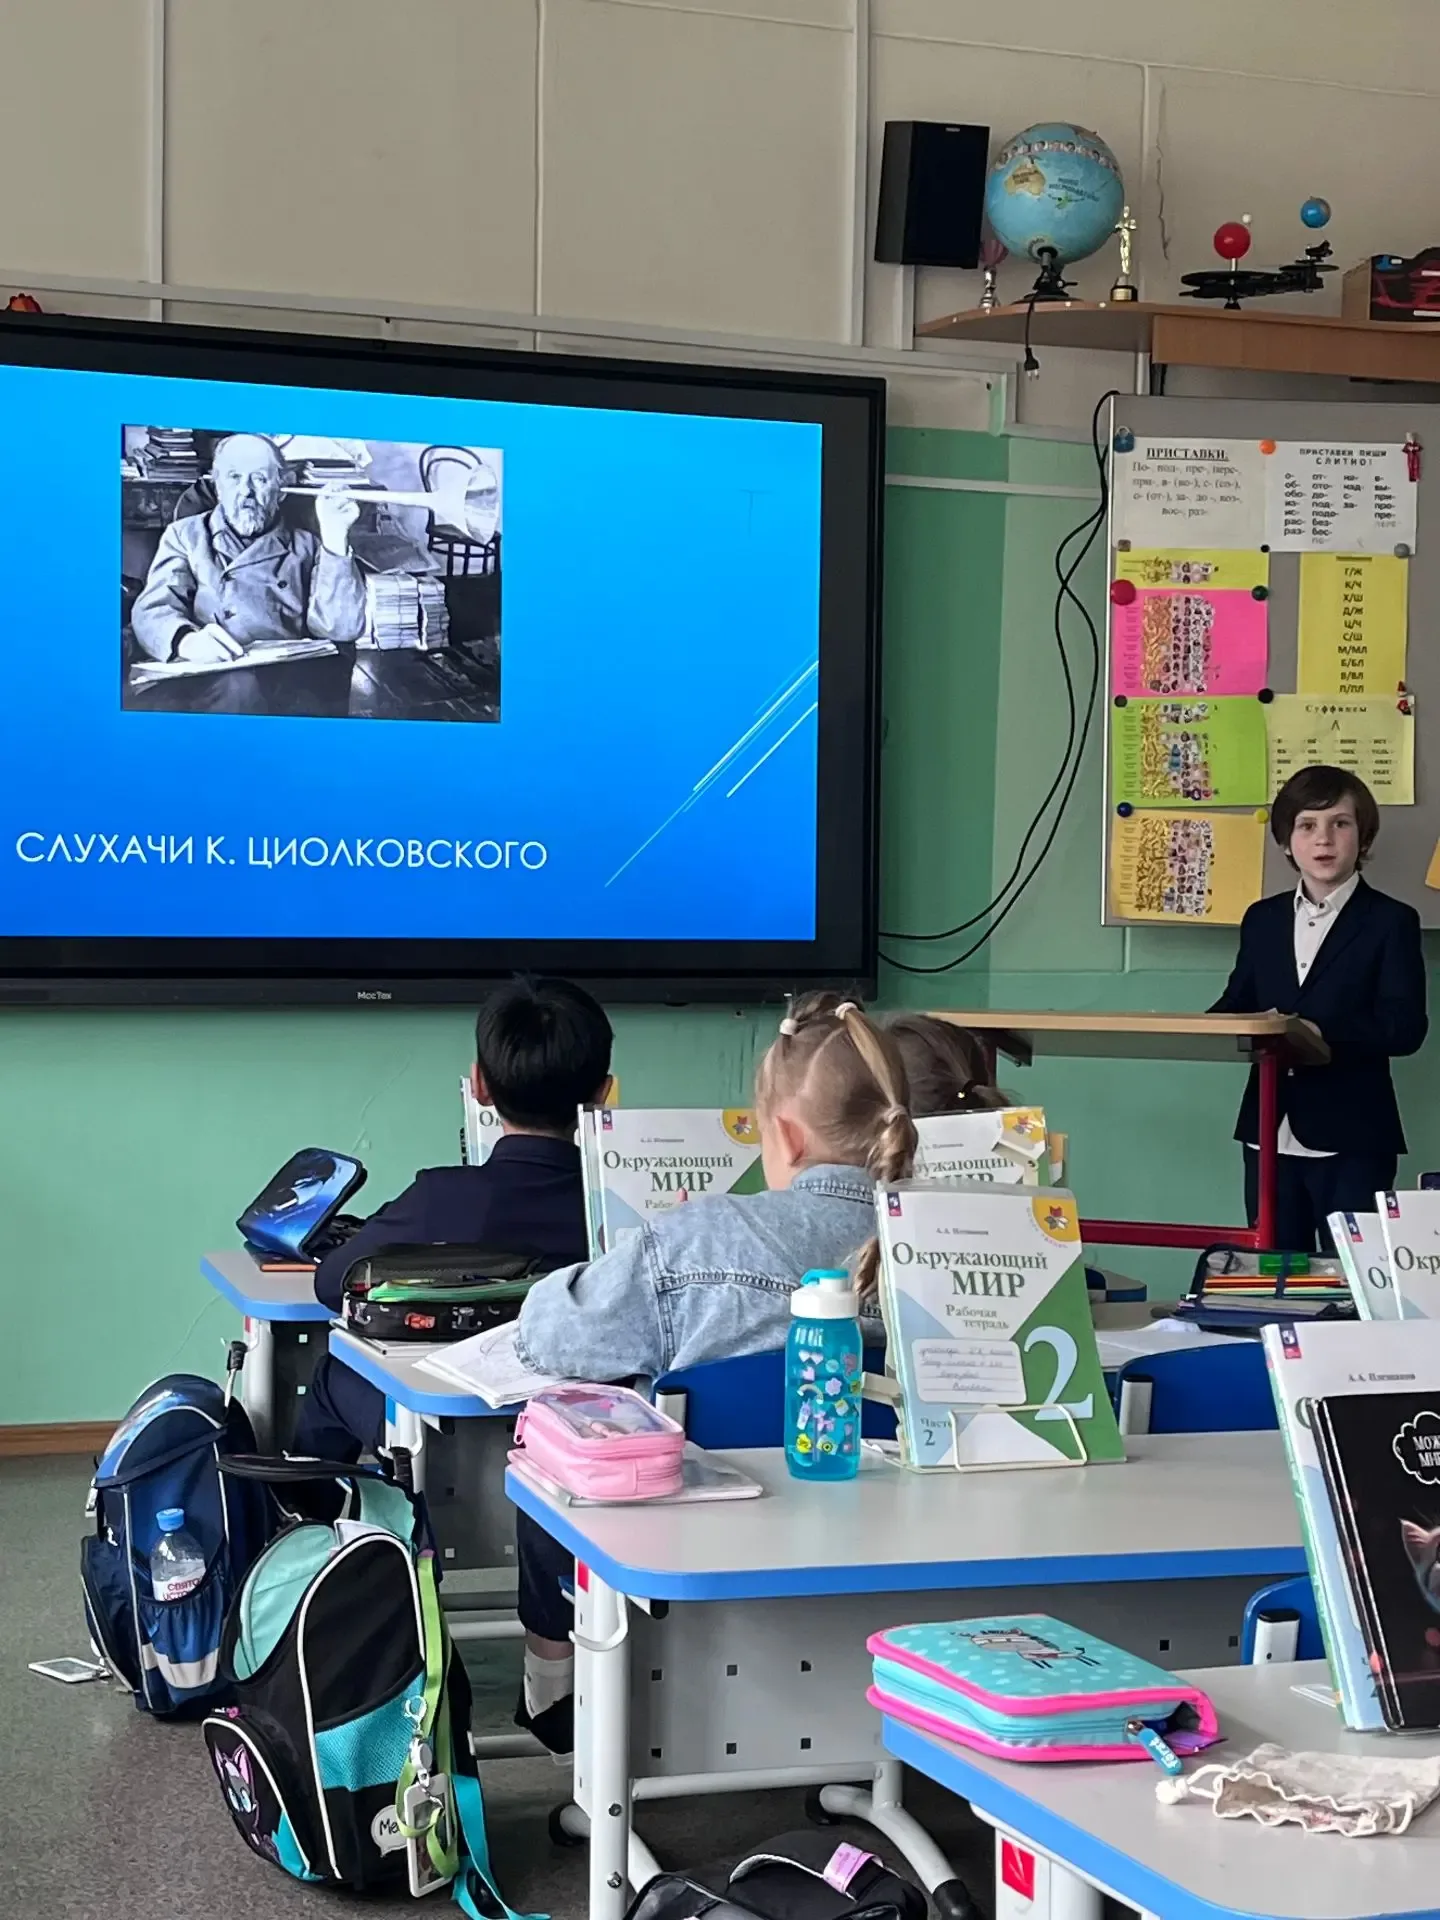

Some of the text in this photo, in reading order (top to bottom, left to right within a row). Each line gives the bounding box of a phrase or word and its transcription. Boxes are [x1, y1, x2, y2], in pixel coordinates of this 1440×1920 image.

[1299, 448, 1387, 457] ПРИСТАВКИ ПИШИ
[1344, 567, 1363, 577] Г/Ж
[1344, 580, 1362, 590] К/Ч
[1343, 593, 1364, 603] Х/Ш
[1342, 606, 1364, 617] Д/Ж
[1344, 619, 1362, 630] Ц/Ч
[1342, 632, 1363, 642] С/Ш
[1337, 645, 1368, 655] М/МЛ
[1340, 658, 1365, 668] Б/БЛ
[1340, 671, 1364, 681] В/ВЛ
[1339, 684, 1365, 694] П/ПЛ
[16, 832, 548, 869] СЛУХАЧИ К. ЦИОЛКОВСКОГО
[603, 1150, 733, 1172] Окружающий
[650, 1171, 714, 1192] МИР
[892, 1241, 1049, 1270] Окружающий
[949, 1269, 1025, 1298] МИР
[945, 1303, 998, 1319] Рабочая
[963, 1318, 1010, 1331] тетрадь
[1024, 1326, 1093, 1421] 2
[923, 1428, 936, 1446] 2
